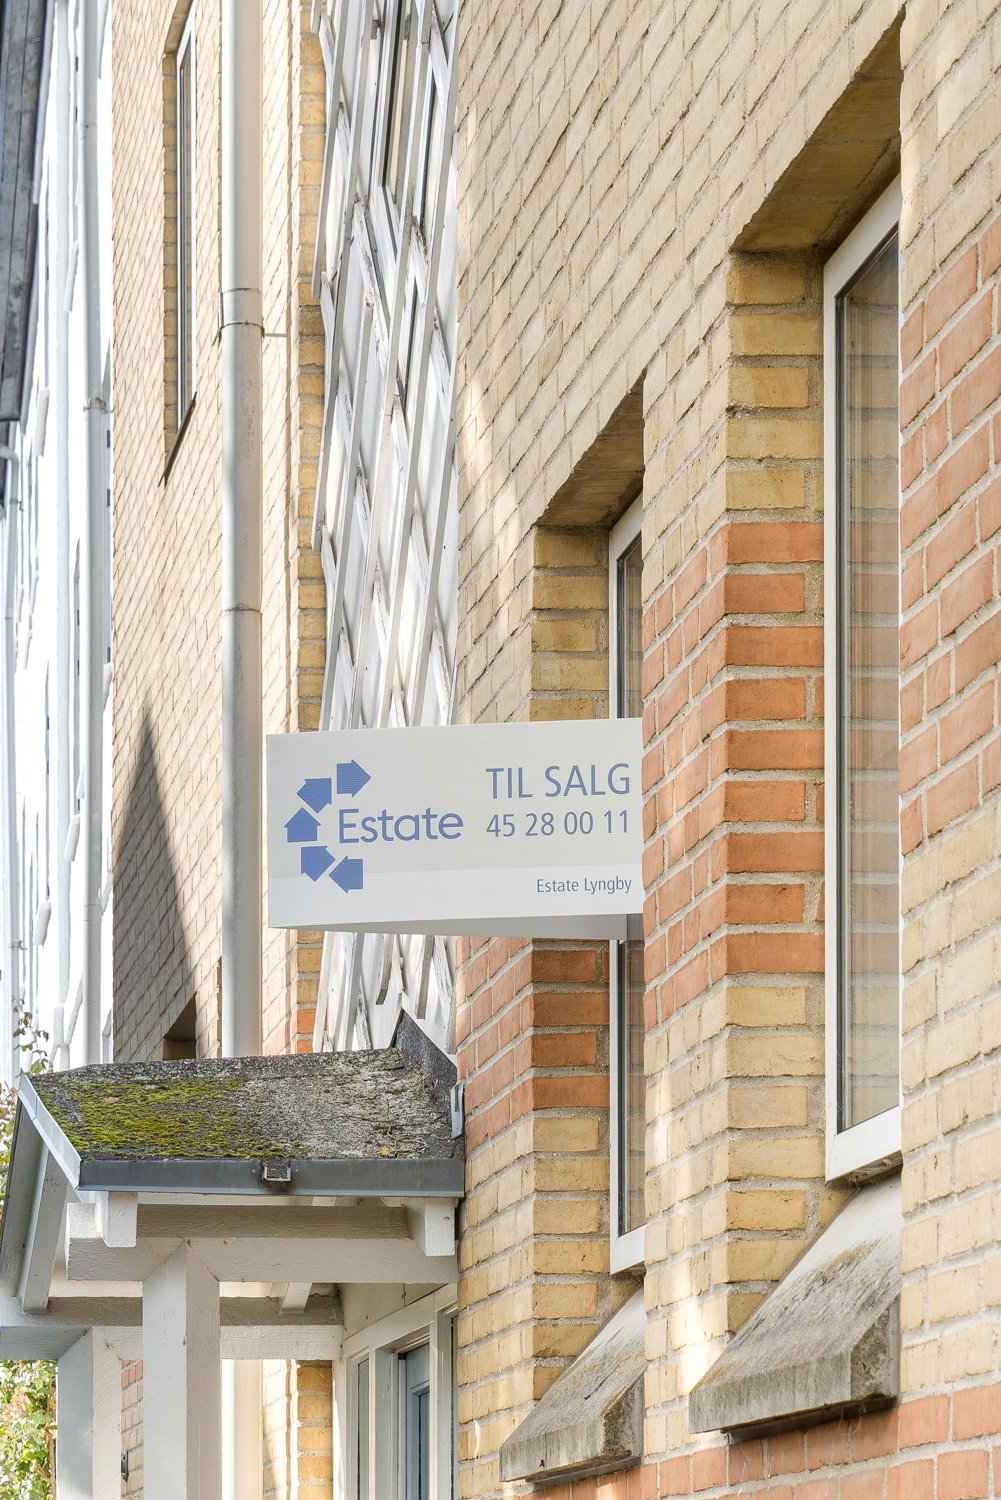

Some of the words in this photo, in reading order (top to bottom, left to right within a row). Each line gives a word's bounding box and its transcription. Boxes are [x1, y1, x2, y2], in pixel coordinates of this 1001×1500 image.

[486, 767, 533, 799] TIL
[545, 763, 631, 797] SALG
[339, 807, 464, 844] Estate
[486, 814, 516, 837] 45
[526, 812, 555, 836] 28
[564, 811, 594, 835] 00
[604, 810, 629, 833] 11
[536, 878, 580, 893] Estate
[584, 876, 633, 895] Lyngby
